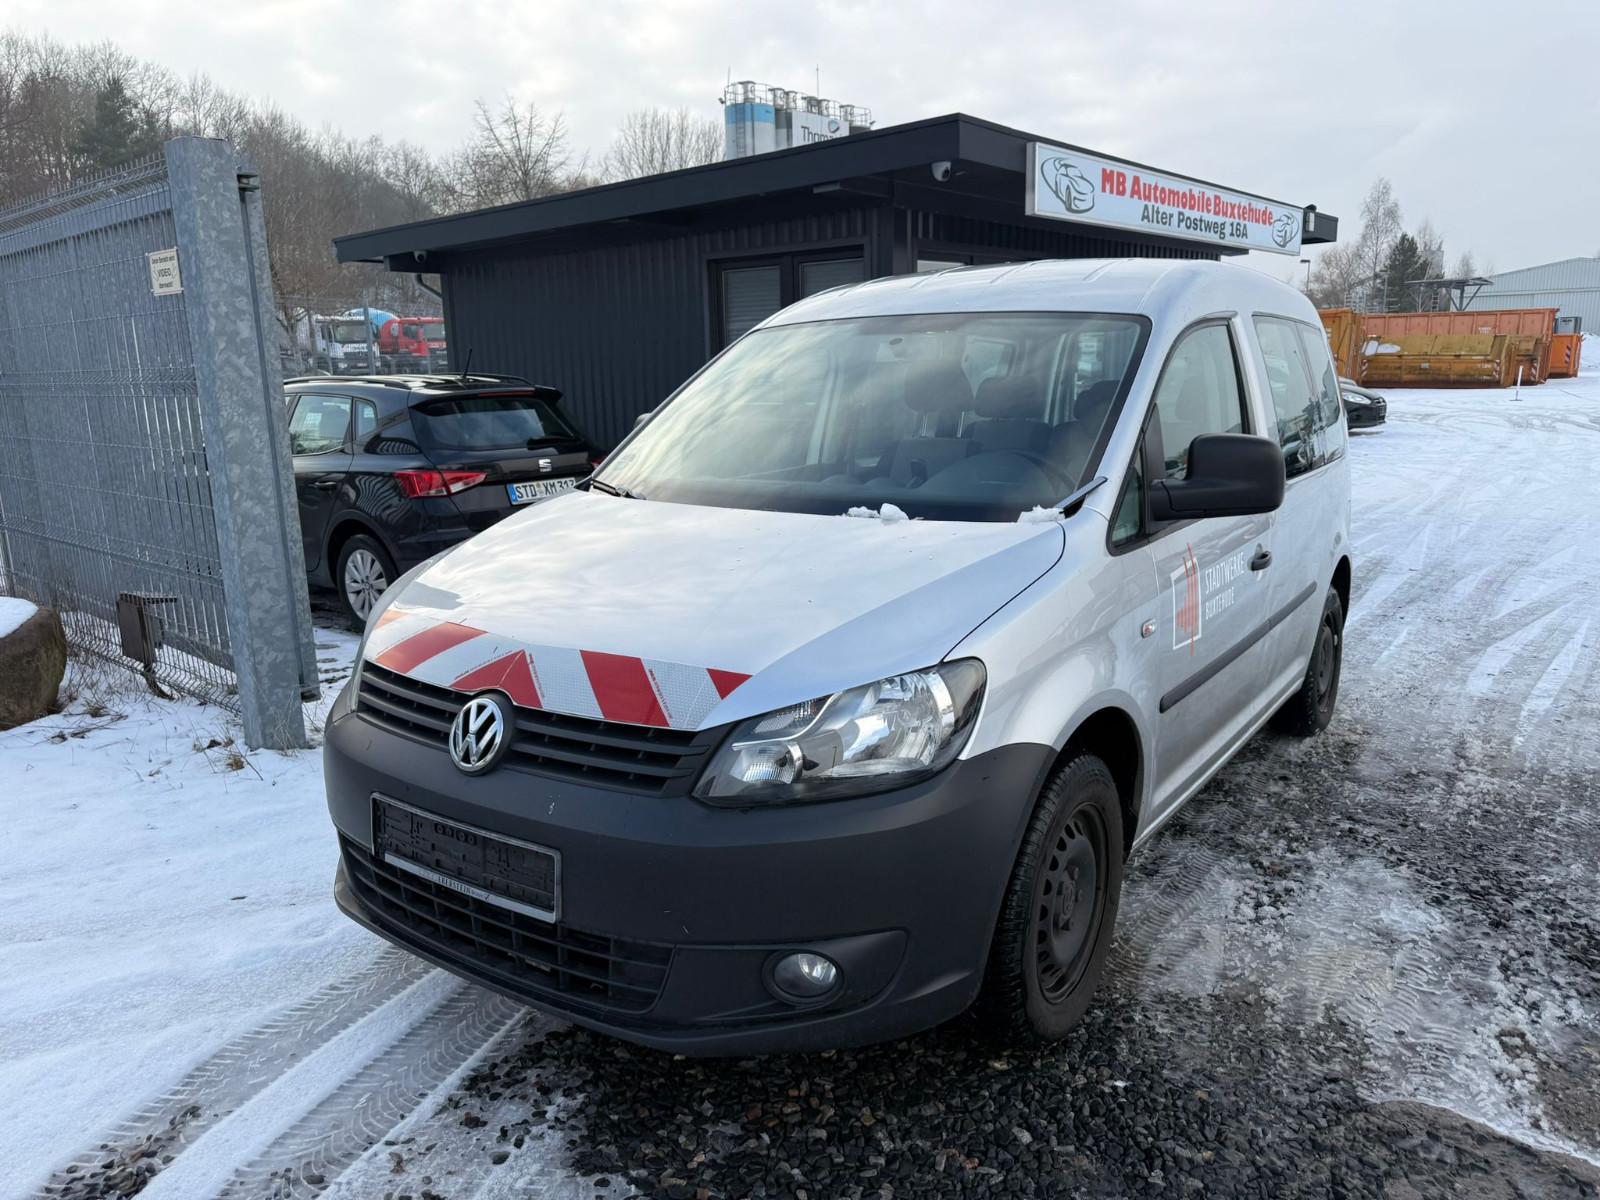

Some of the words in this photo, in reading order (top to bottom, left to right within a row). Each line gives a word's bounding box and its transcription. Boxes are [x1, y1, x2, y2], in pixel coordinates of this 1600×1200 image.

[1101, 167, 1127, 196] MB
[1130, 175, 1212, 214] Automobile
[1213, 195, 1274, 226] Buxtehude
[1141, 204, 1174, 226] Alter
[1177, 211, 1226, 240] Postweg
[1229, 222, 1248, 240] 16A
[516, 483, 537, 499] STD
[543, 481, 558, 496] XM
